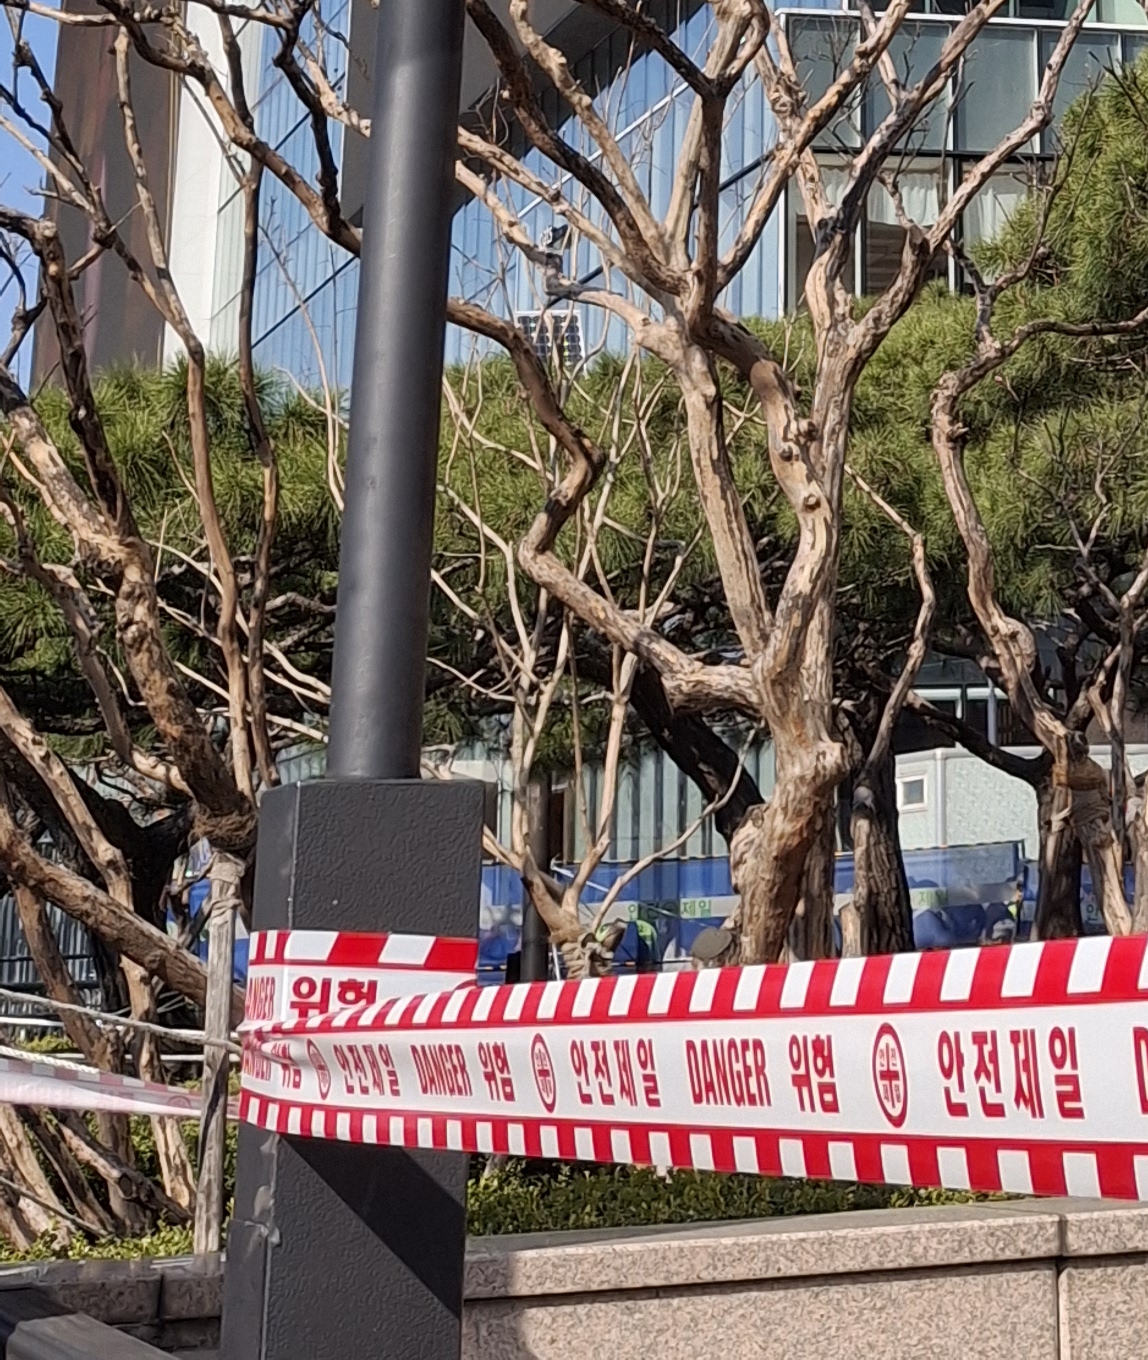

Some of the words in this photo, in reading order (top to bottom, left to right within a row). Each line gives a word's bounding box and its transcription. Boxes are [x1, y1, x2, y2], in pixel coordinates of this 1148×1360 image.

[333, 1043, 401, 1097] 안전제일
[410, 1044, 472, 1097] DANGER
[478, 1041, 516, 1102] 위험
[570, 1038, 661, 1108] 안전제일
[685, 1038, 772, 1107] DANGER
[789, 1034, 840, 1114] 위험
[937, 1025, 1085, 1120] 안전제일
